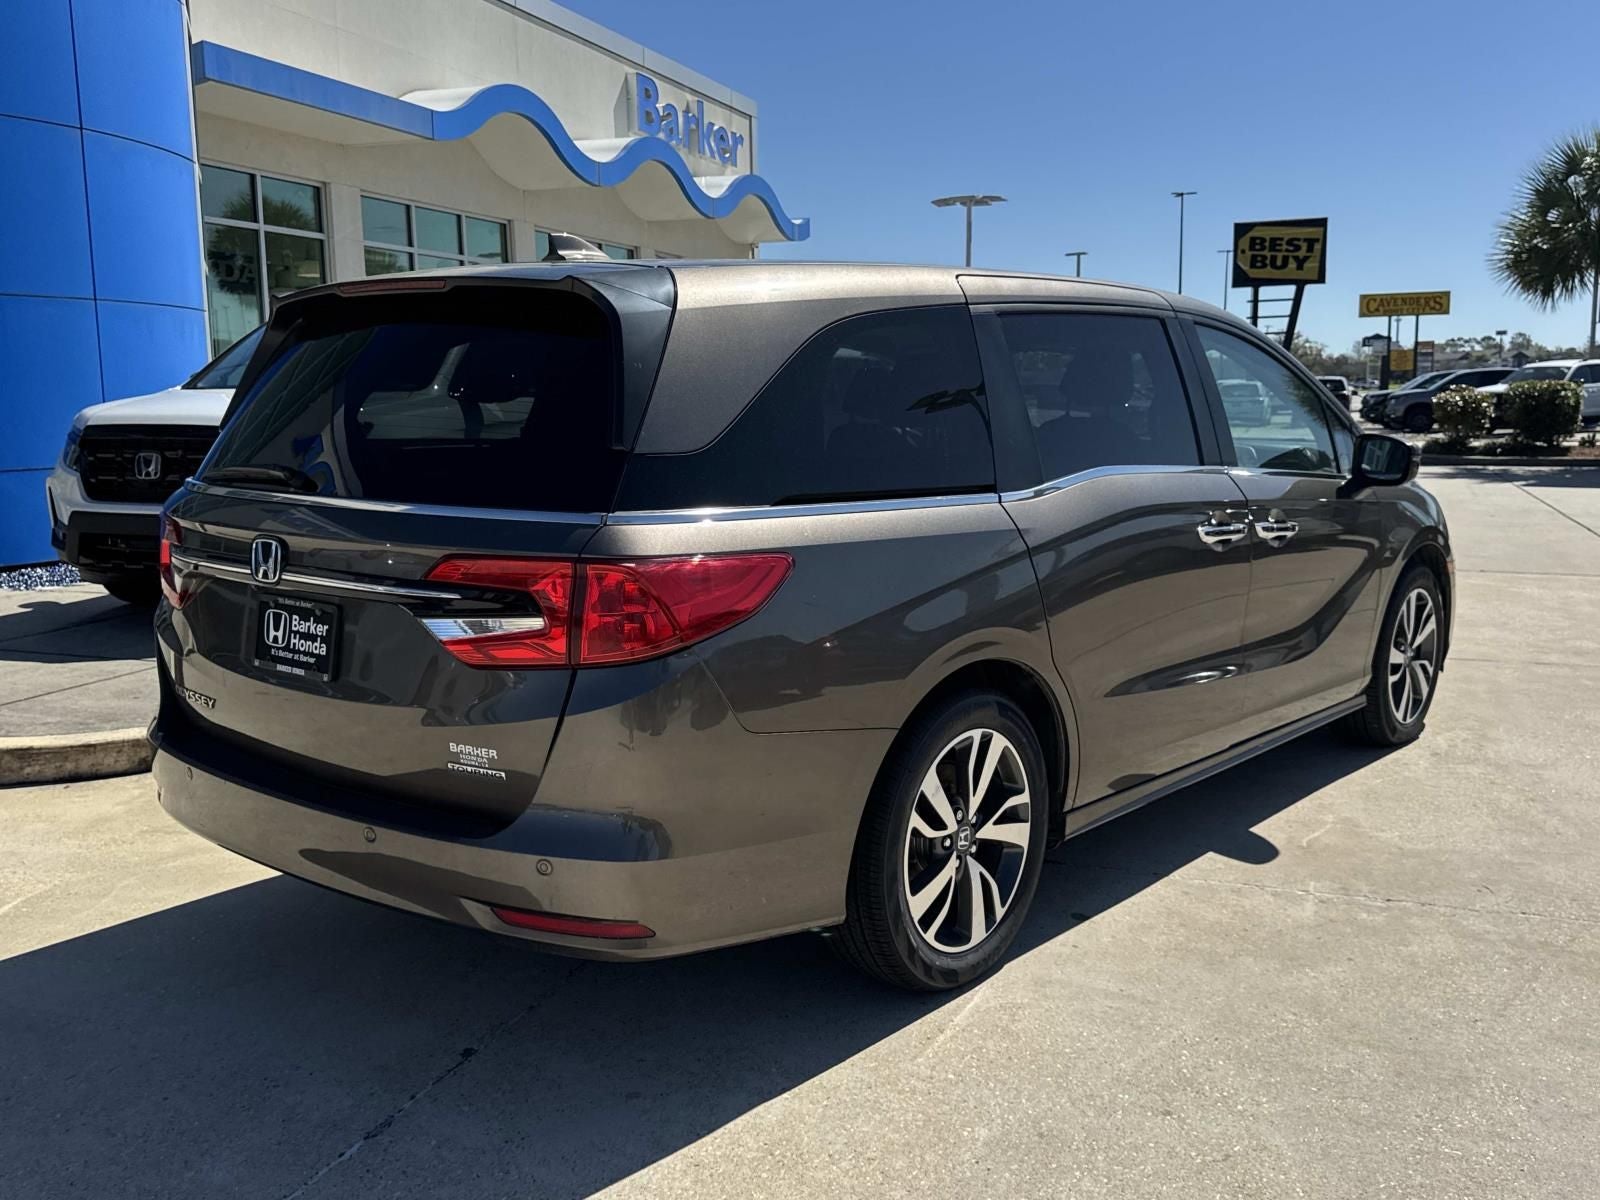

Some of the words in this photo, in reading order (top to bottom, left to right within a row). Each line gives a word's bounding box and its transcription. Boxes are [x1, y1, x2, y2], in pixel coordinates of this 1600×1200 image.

[636, 72, 744, 168] Barker
[1249, 236, 1321, 255] BEST
[1249, 253, 1312, 272] BUY
[1365, 294, 1444, 313] CAVENDER'S
[291, 614, 329, 637] Barker
[289, 632, 327, 656] Honda
[449, 742, 498, 760] BARKER
